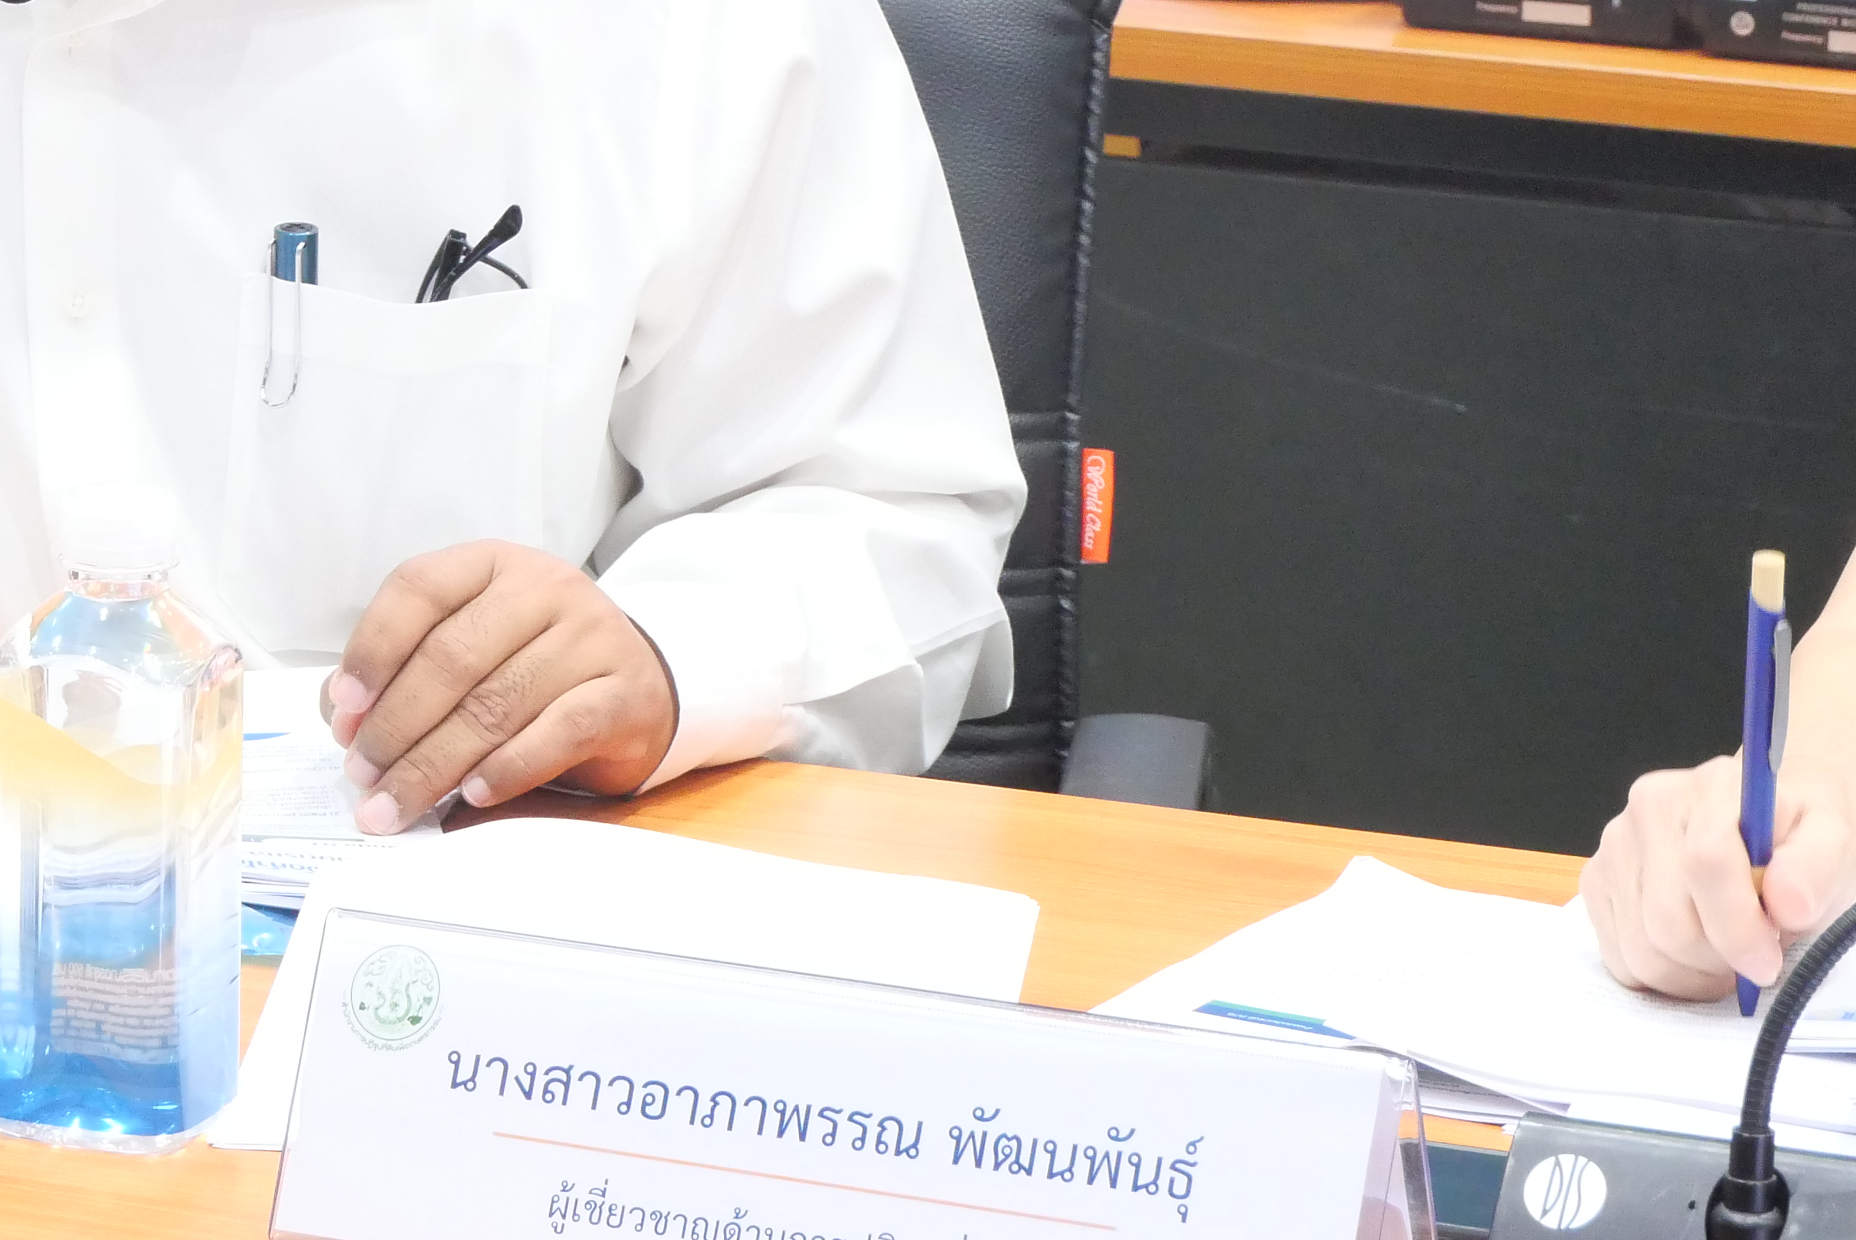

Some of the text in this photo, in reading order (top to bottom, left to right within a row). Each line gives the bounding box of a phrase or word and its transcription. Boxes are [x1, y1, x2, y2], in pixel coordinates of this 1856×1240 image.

[1084, 455, 1107, 550] World Class
[447, 1050, 1205, 1224] นางสาวอาภาพรรณ พัฒนพันธุ์
